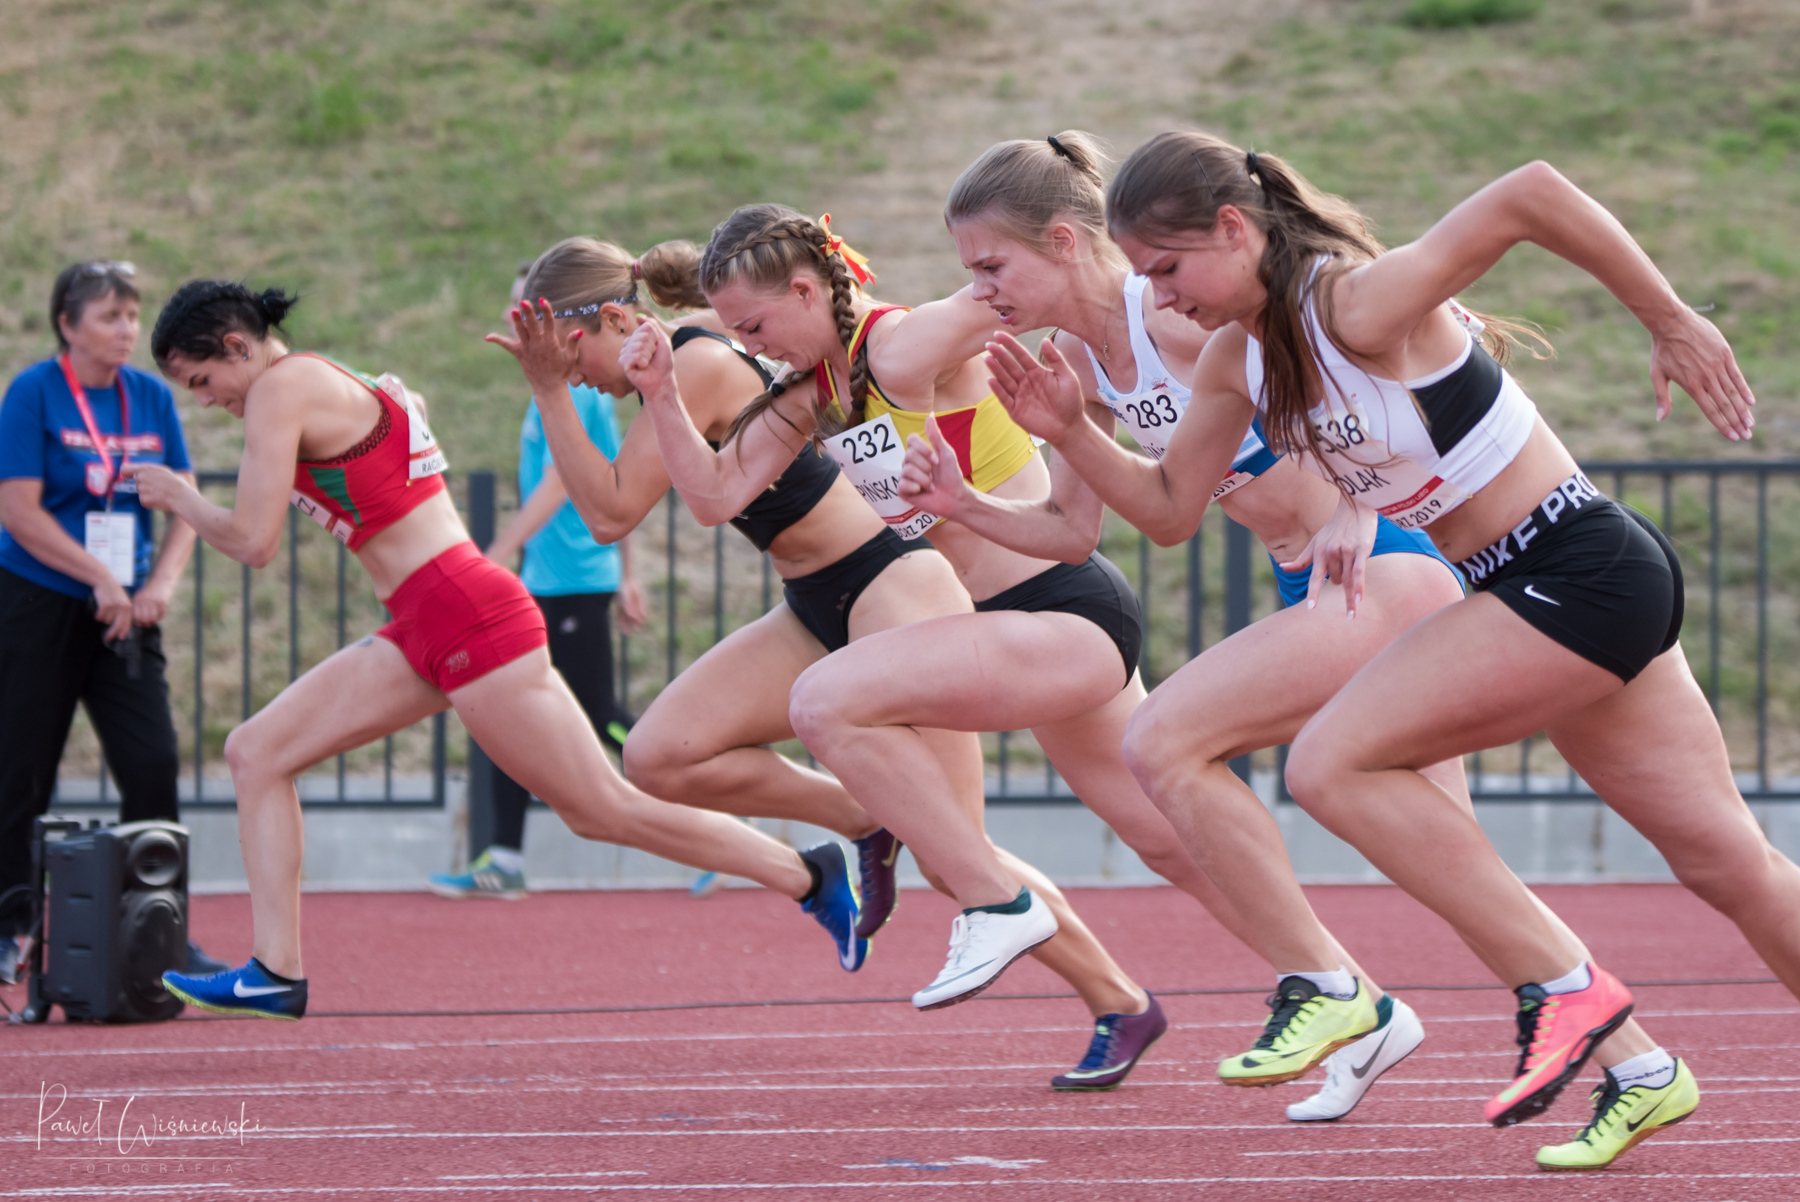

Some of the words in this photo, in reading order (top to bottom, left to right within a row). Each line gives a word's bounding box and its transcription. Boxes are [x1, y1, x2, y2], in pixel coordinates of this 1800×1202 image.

[1126, 394, 1178, 429] 283
[842, 423, 897, 465] 232
[1335, 467, 1391, 496] OLAK
[1540, 470, 1600, 525] PRO
[1409, 499, 1442, 524] 2019
